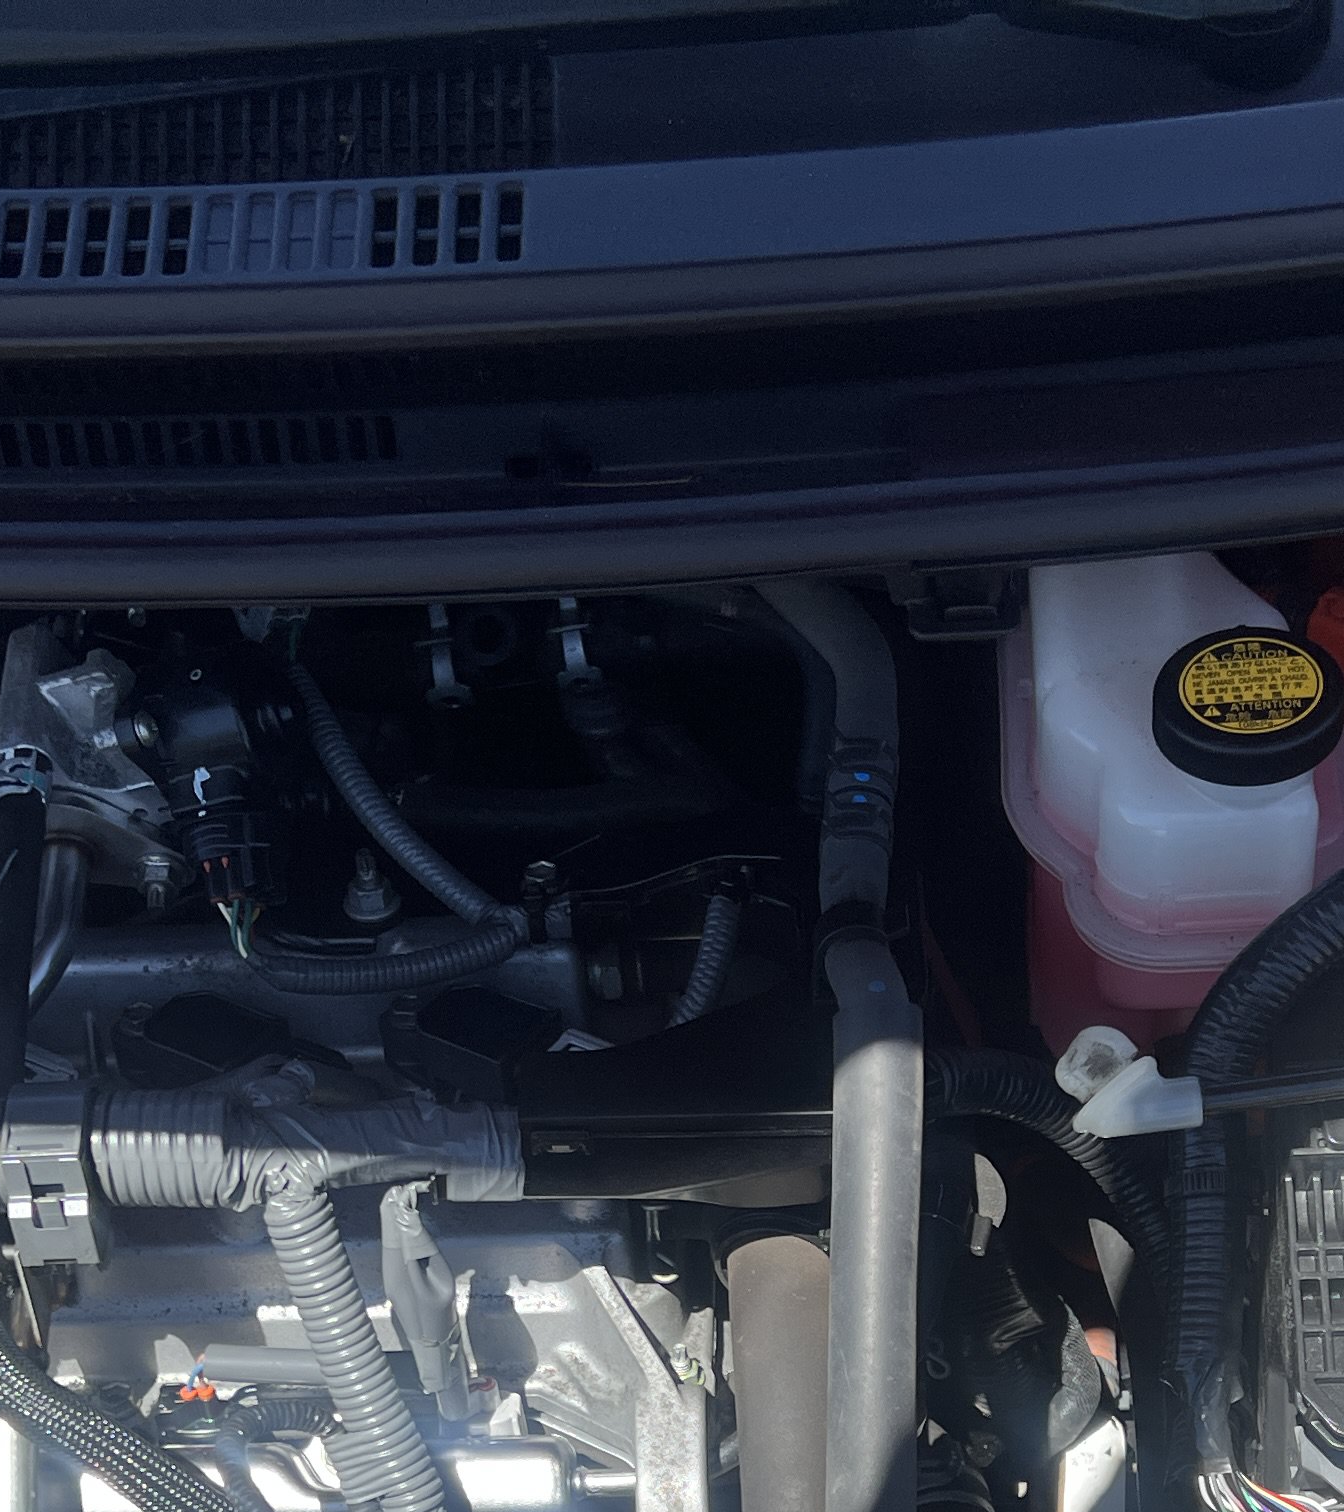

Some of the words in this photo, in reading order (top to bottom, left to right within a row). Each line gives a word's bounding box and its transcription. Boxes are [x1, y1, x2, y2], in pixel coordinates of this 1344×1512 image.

[1221, 649, 1287, 660] CAUTION
[1207, 678, 1234, 686] JAMAIS
[1238, 676, 1266, 684] OUVRIR
[1230, 699, 1301, 711] ATTENTION
